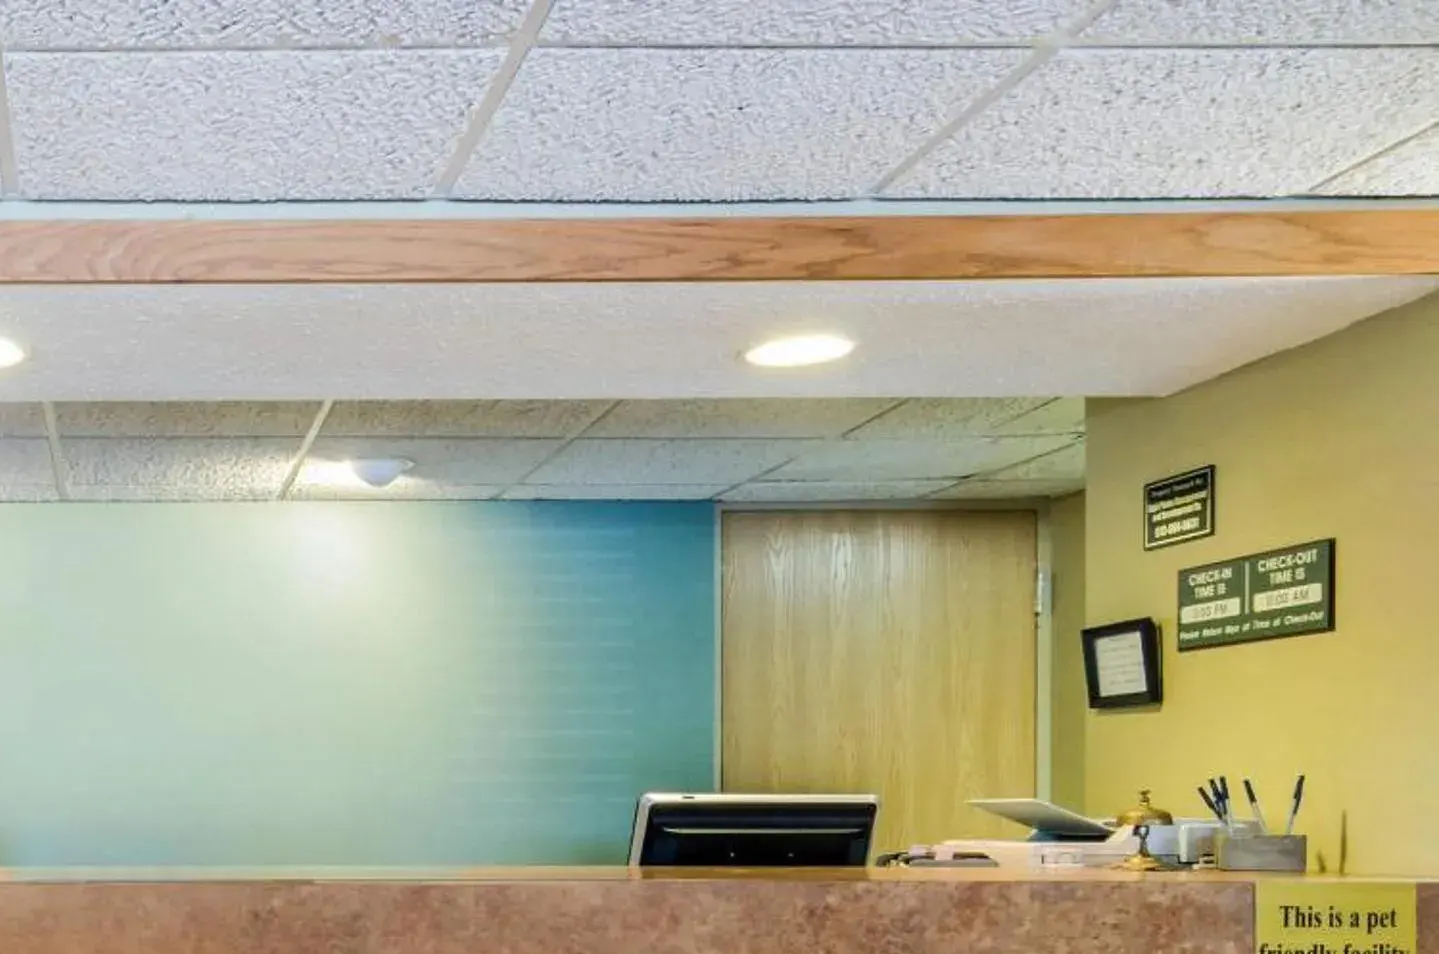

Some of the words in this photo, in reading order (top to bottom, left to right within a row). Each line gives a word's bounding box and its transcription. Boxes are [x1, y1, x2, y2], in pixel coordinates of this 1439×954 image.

[1258, 548, 1318, 572] CHECK-OUT
[1188, 567, 1232, 586] CHECK-IN
[1269, 568, 1293, 585] TIME
[1295, 566, 1306, 580] IS
[1194, 584, 1215, 599] TIME
[1279, 905, 1322, 928] This
[1328, 905, 1342, 928] is
[1349, 911, 1361, 928] a
[1367, 907, 1398, 934] pet
